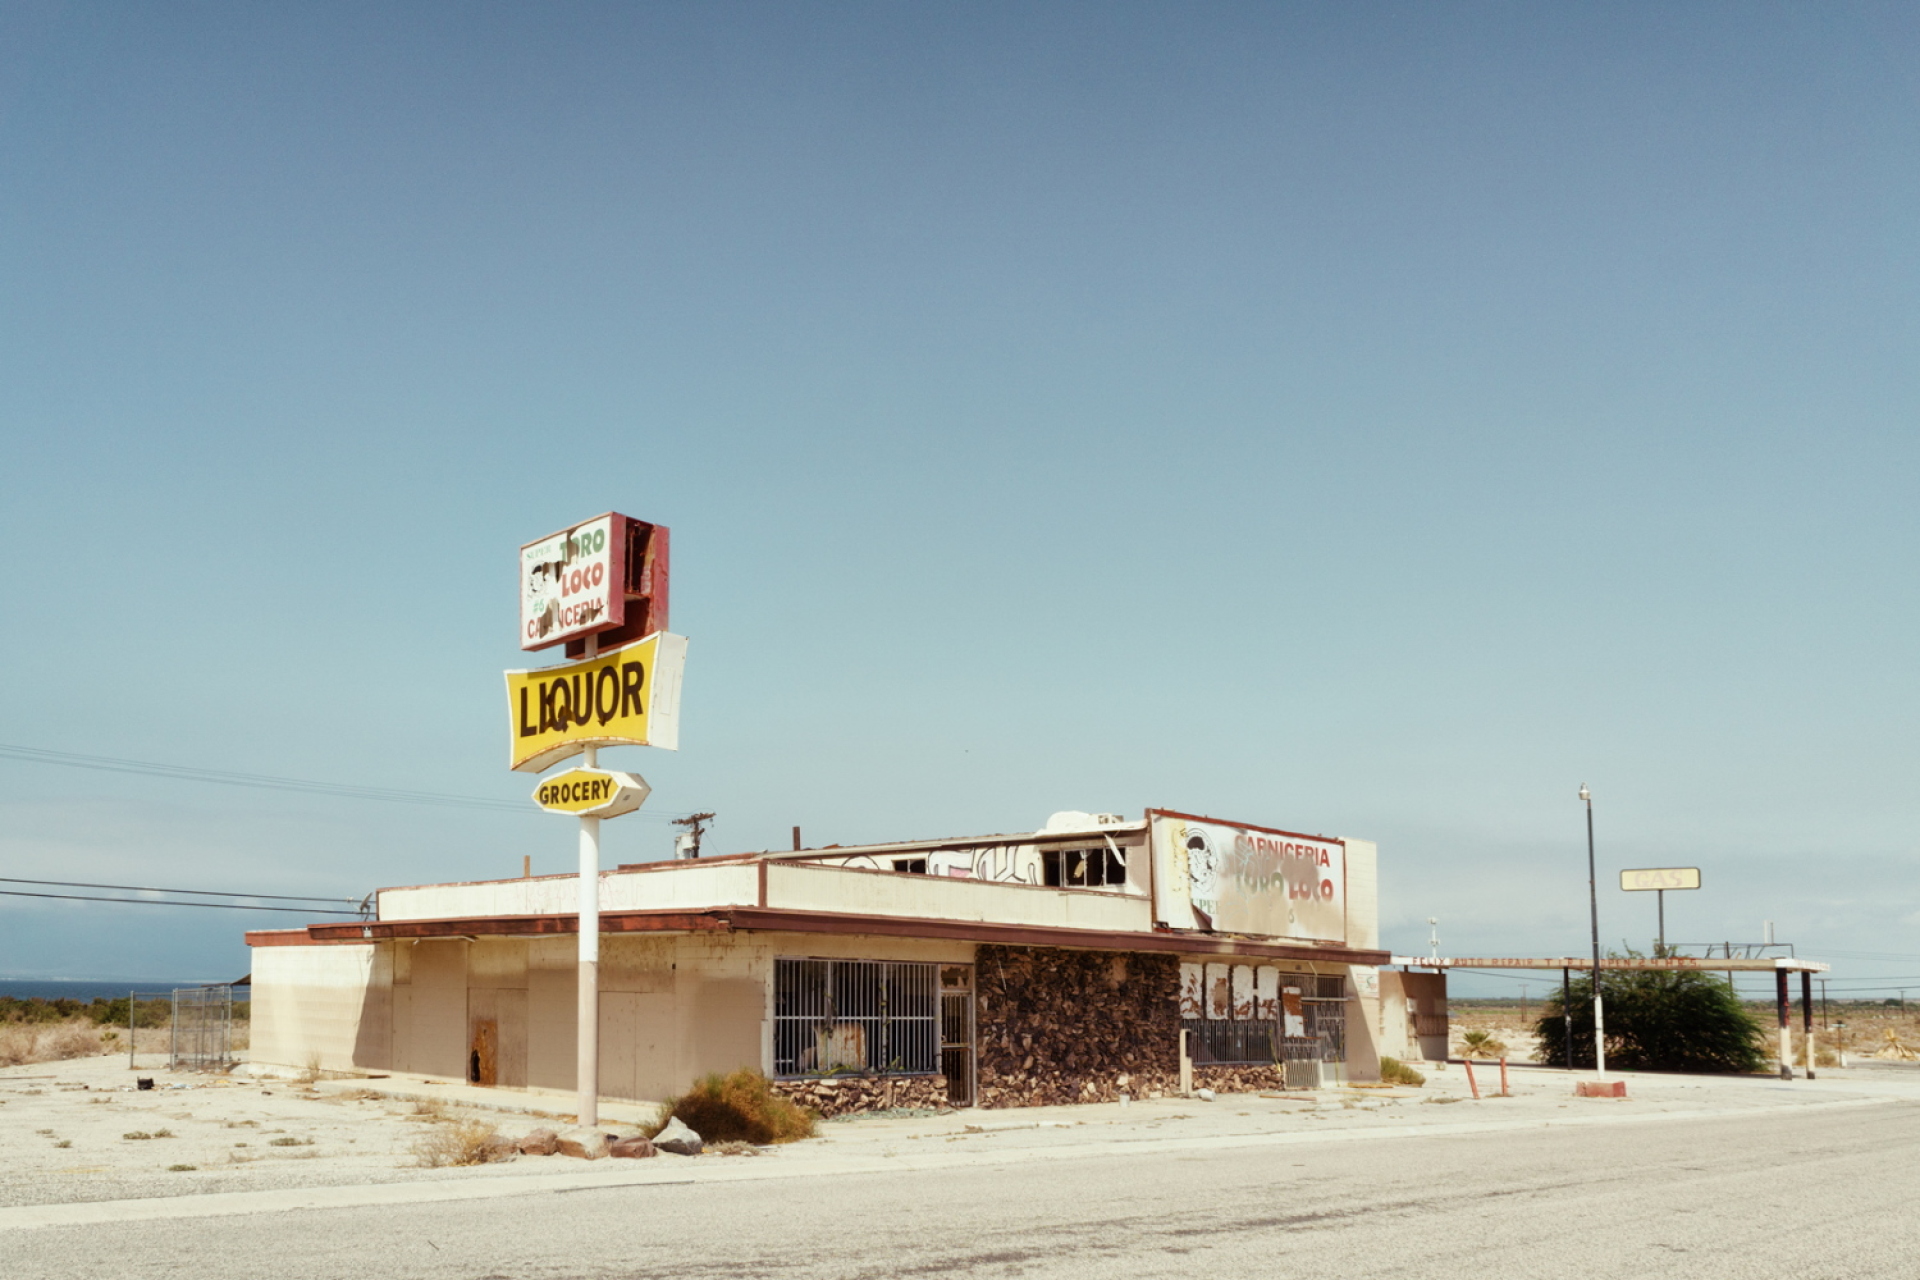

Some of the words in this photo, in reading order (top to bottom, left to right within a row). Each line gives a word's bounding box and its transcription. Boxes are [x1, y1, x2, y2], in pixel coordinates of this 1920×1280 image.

[561, 562, 604, 598] LOCO
[520, 660, 645, 738] LIQUOR
[539, 778, 613, 805] GROCERY
[1634, 869, 1684, 888] GAS
[1453, 958, 1484, 967] AUTO
[1492, 958, 1534, 967] REPAIR
